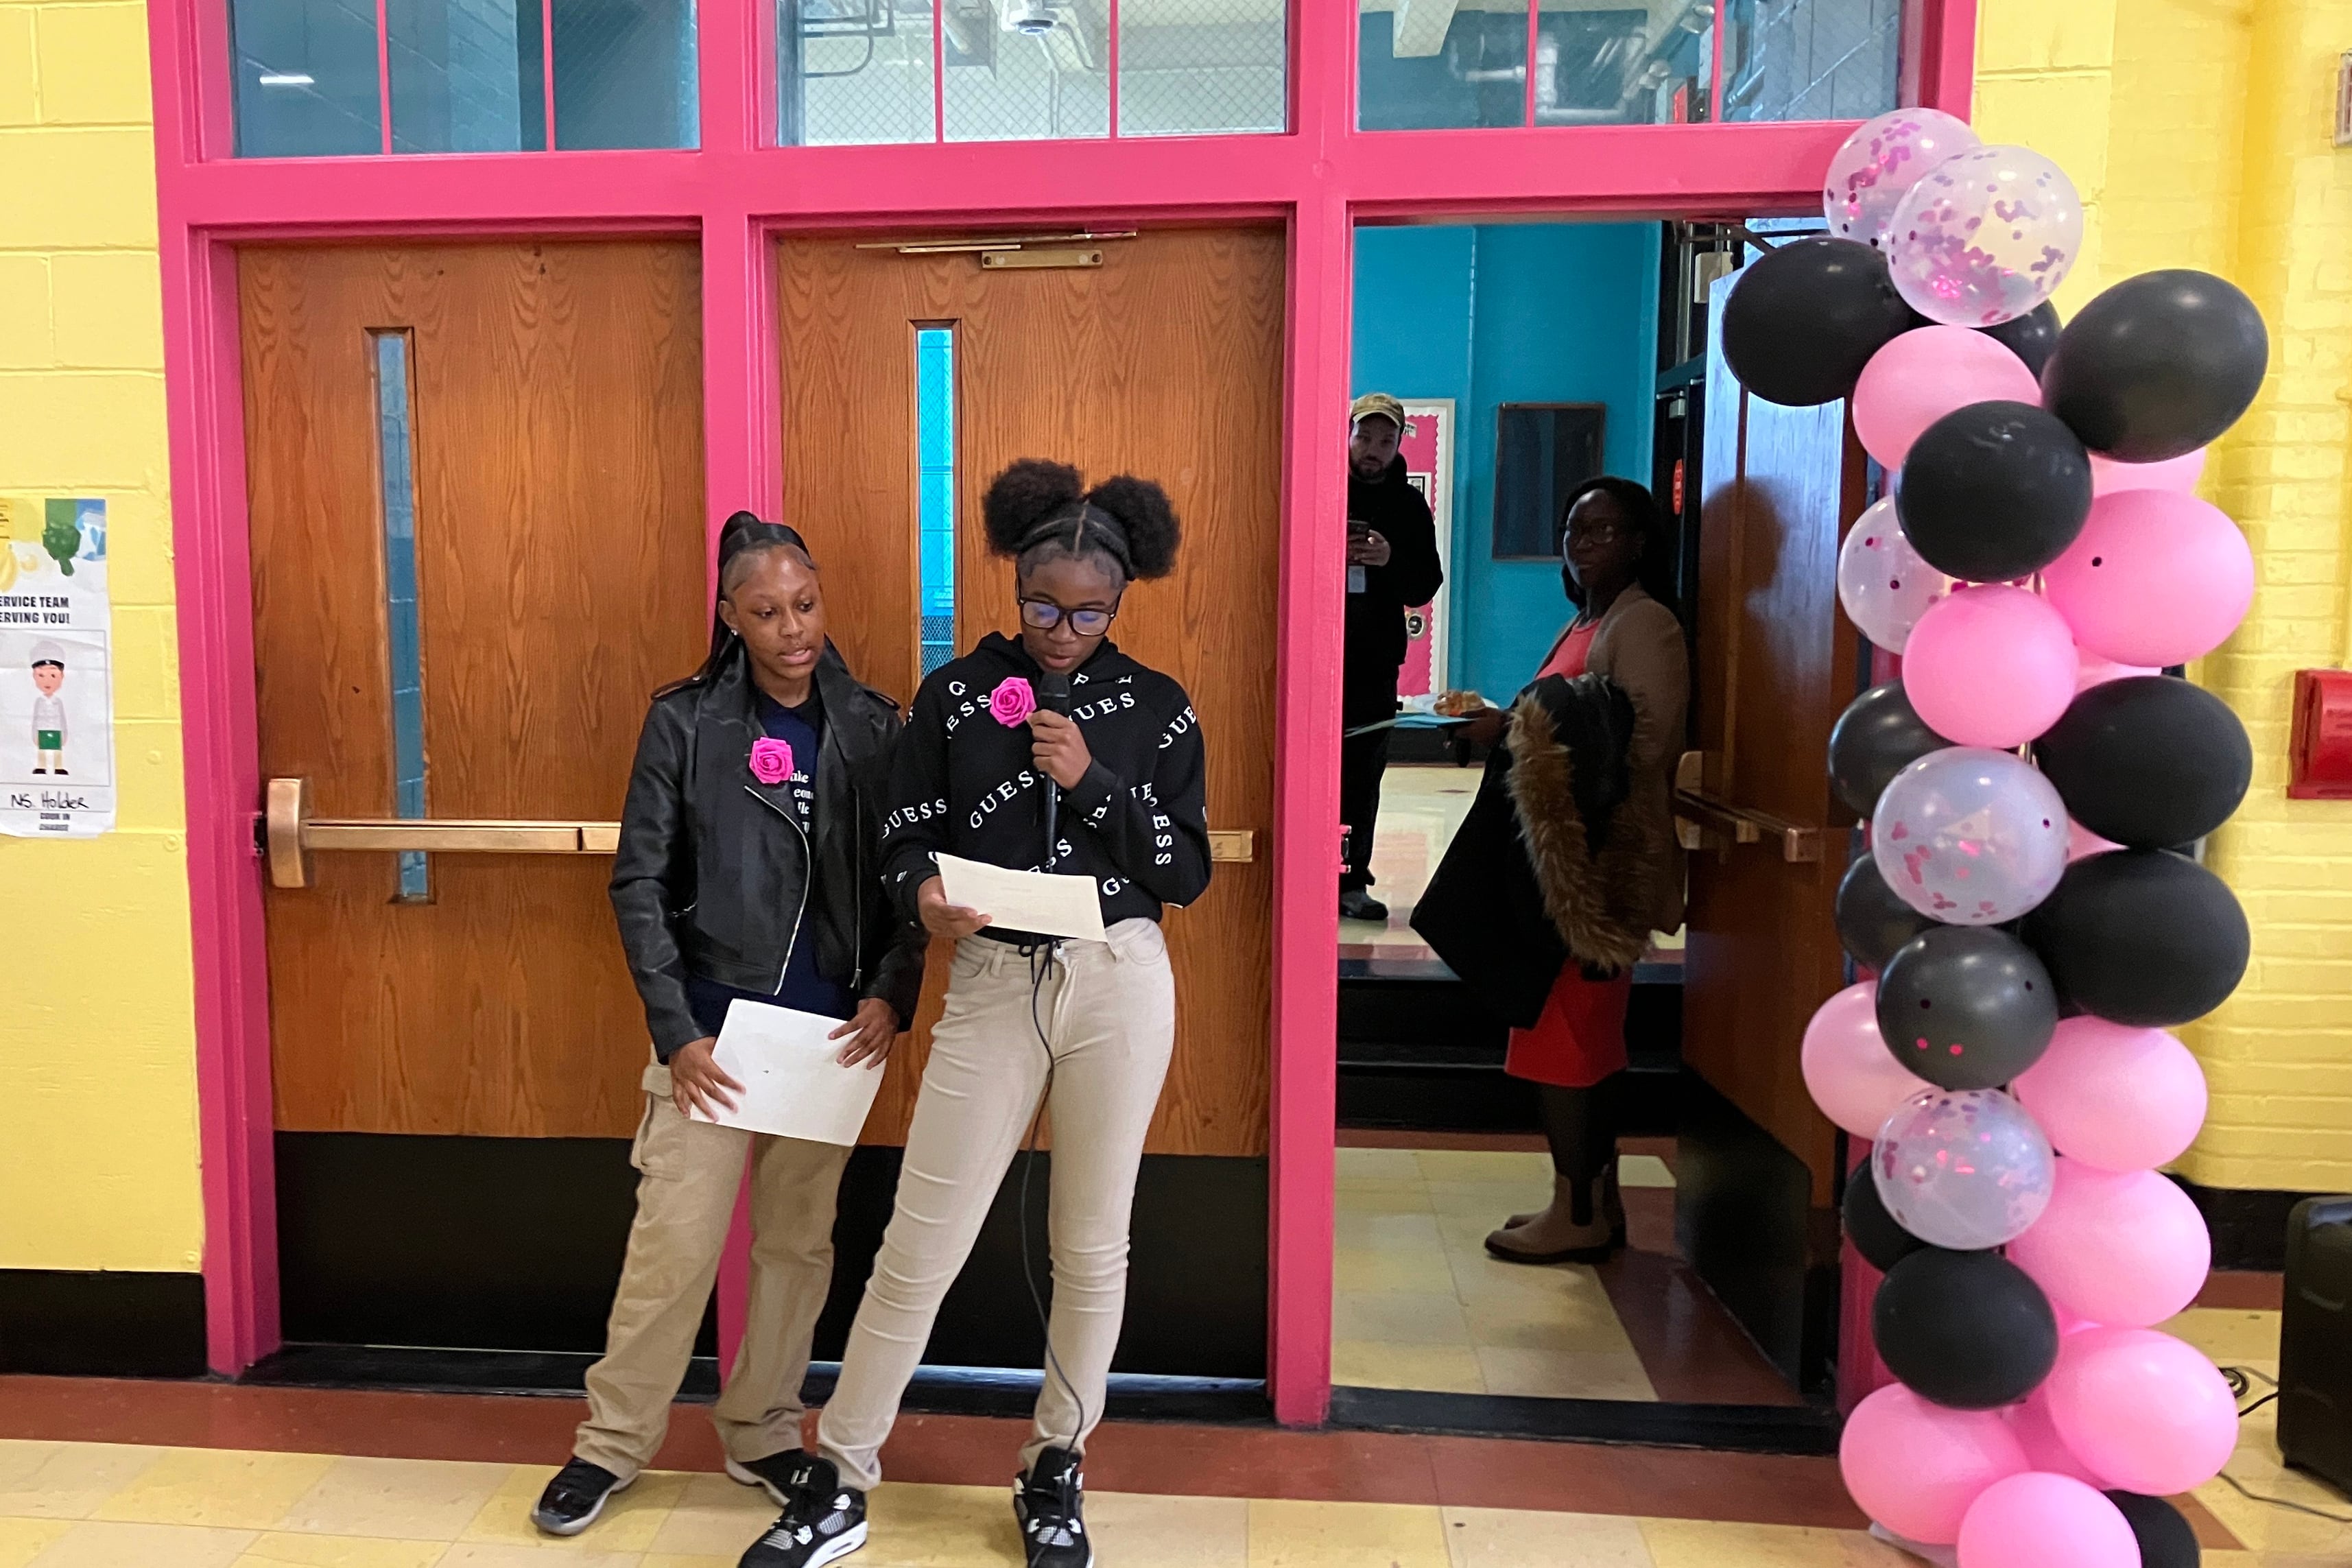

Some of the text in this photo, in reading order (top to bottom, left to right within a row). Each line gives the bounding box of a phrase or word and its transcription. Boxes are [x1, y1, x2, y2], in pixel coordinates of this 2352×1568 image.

[40, 597, 69, 608] TEAM
[43, 613, 70, 623] YOU!
[947, 694, 991, 739] ESS
[1068, 692, 1135, 722] UES
[970, 770, 1045, 829] GUES
